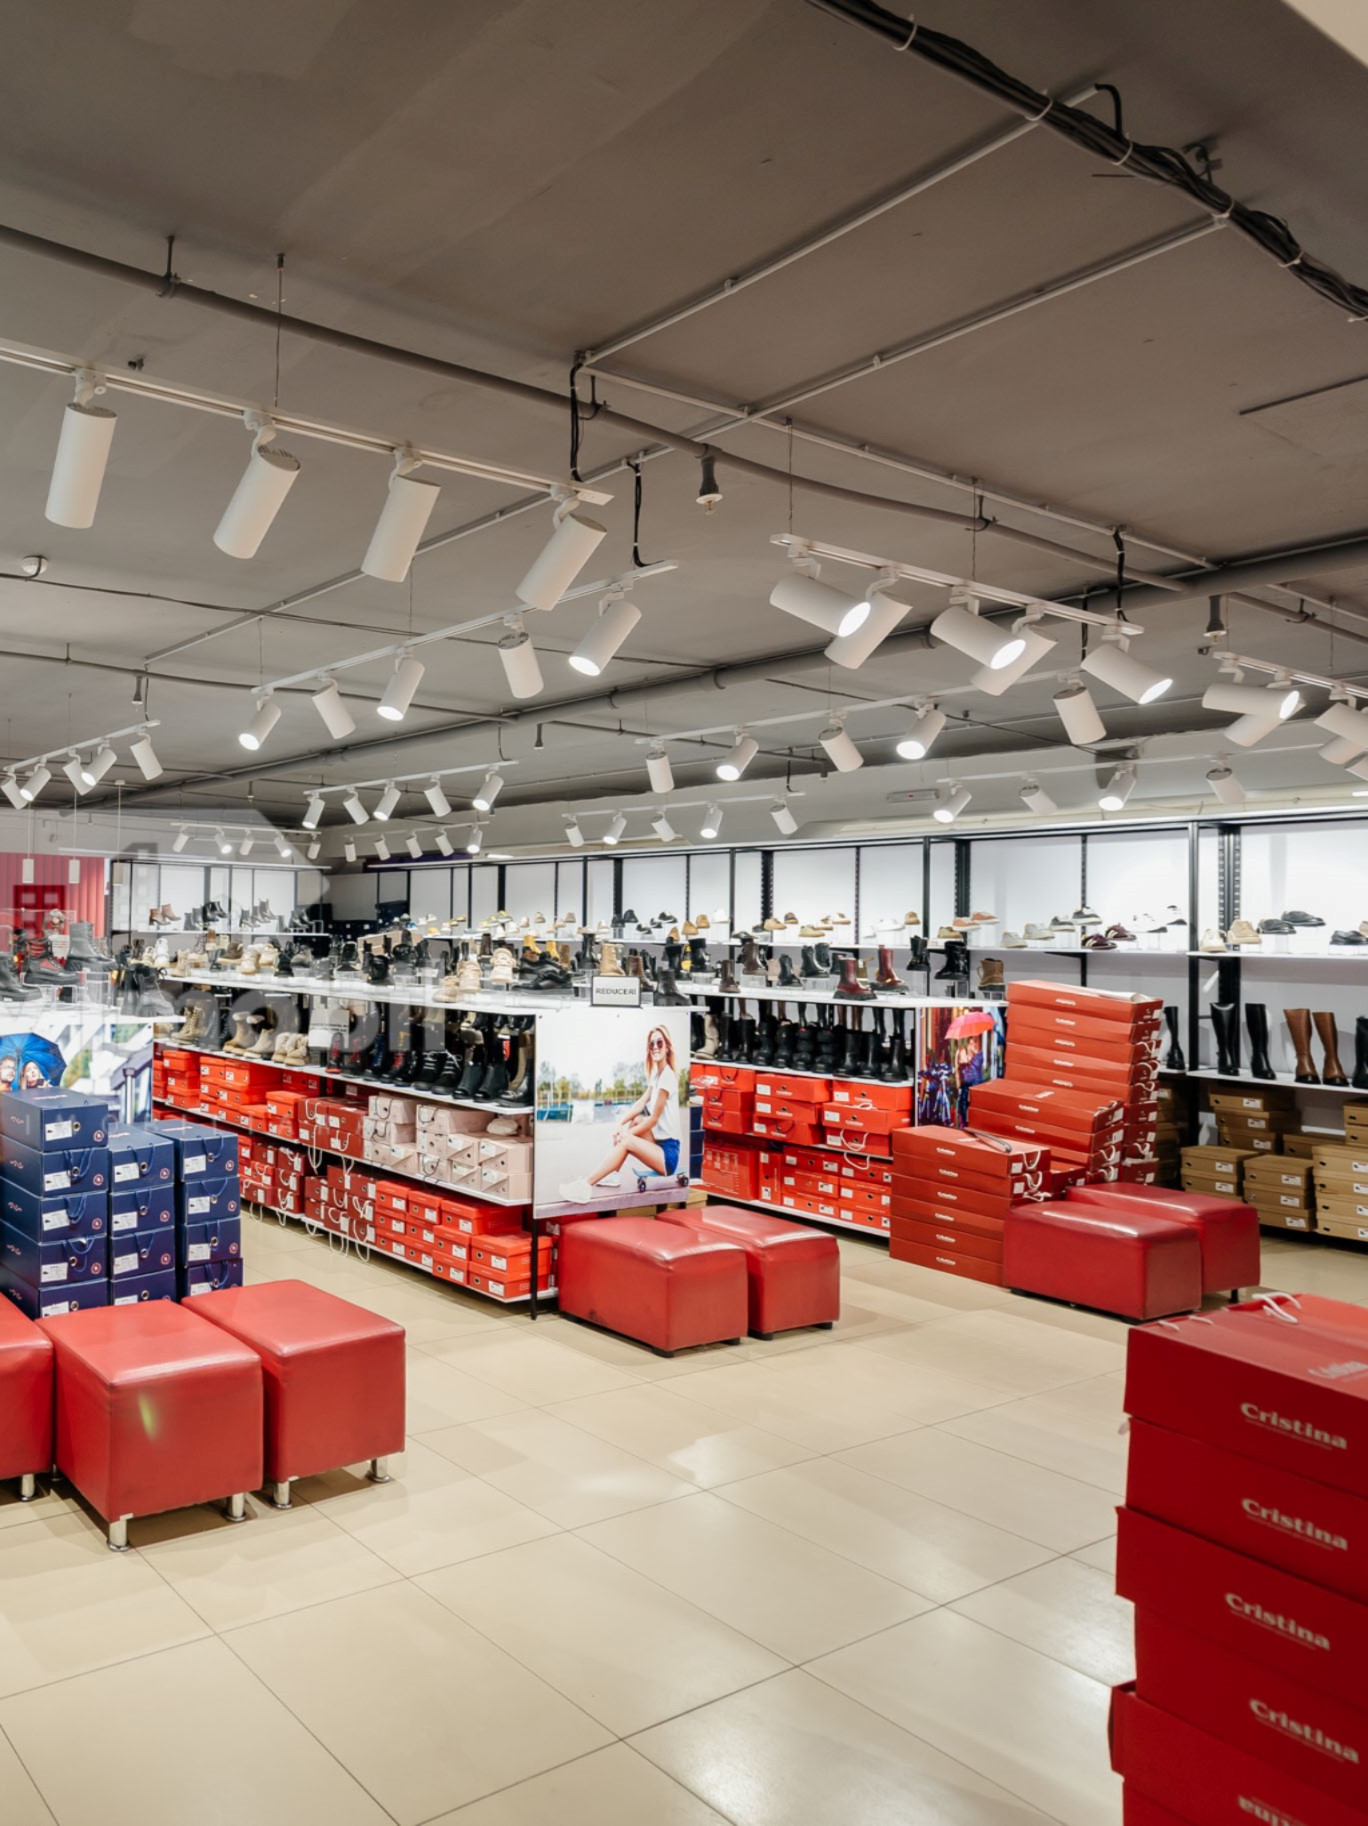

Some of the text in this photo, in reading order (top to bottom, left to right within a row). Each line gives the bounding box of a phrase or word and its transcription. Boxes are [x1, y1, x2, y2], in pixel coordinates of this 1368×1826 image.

[595, 987, 637, 996] REDUCERI
[1241, 1402, 1348, 1450] Cristina
[1242, 1498, 1348, 1550] Cristina
[1225, 1592, 1331, 1651] Cristina
[1249, 1698, 1360, 1764] Cristina
